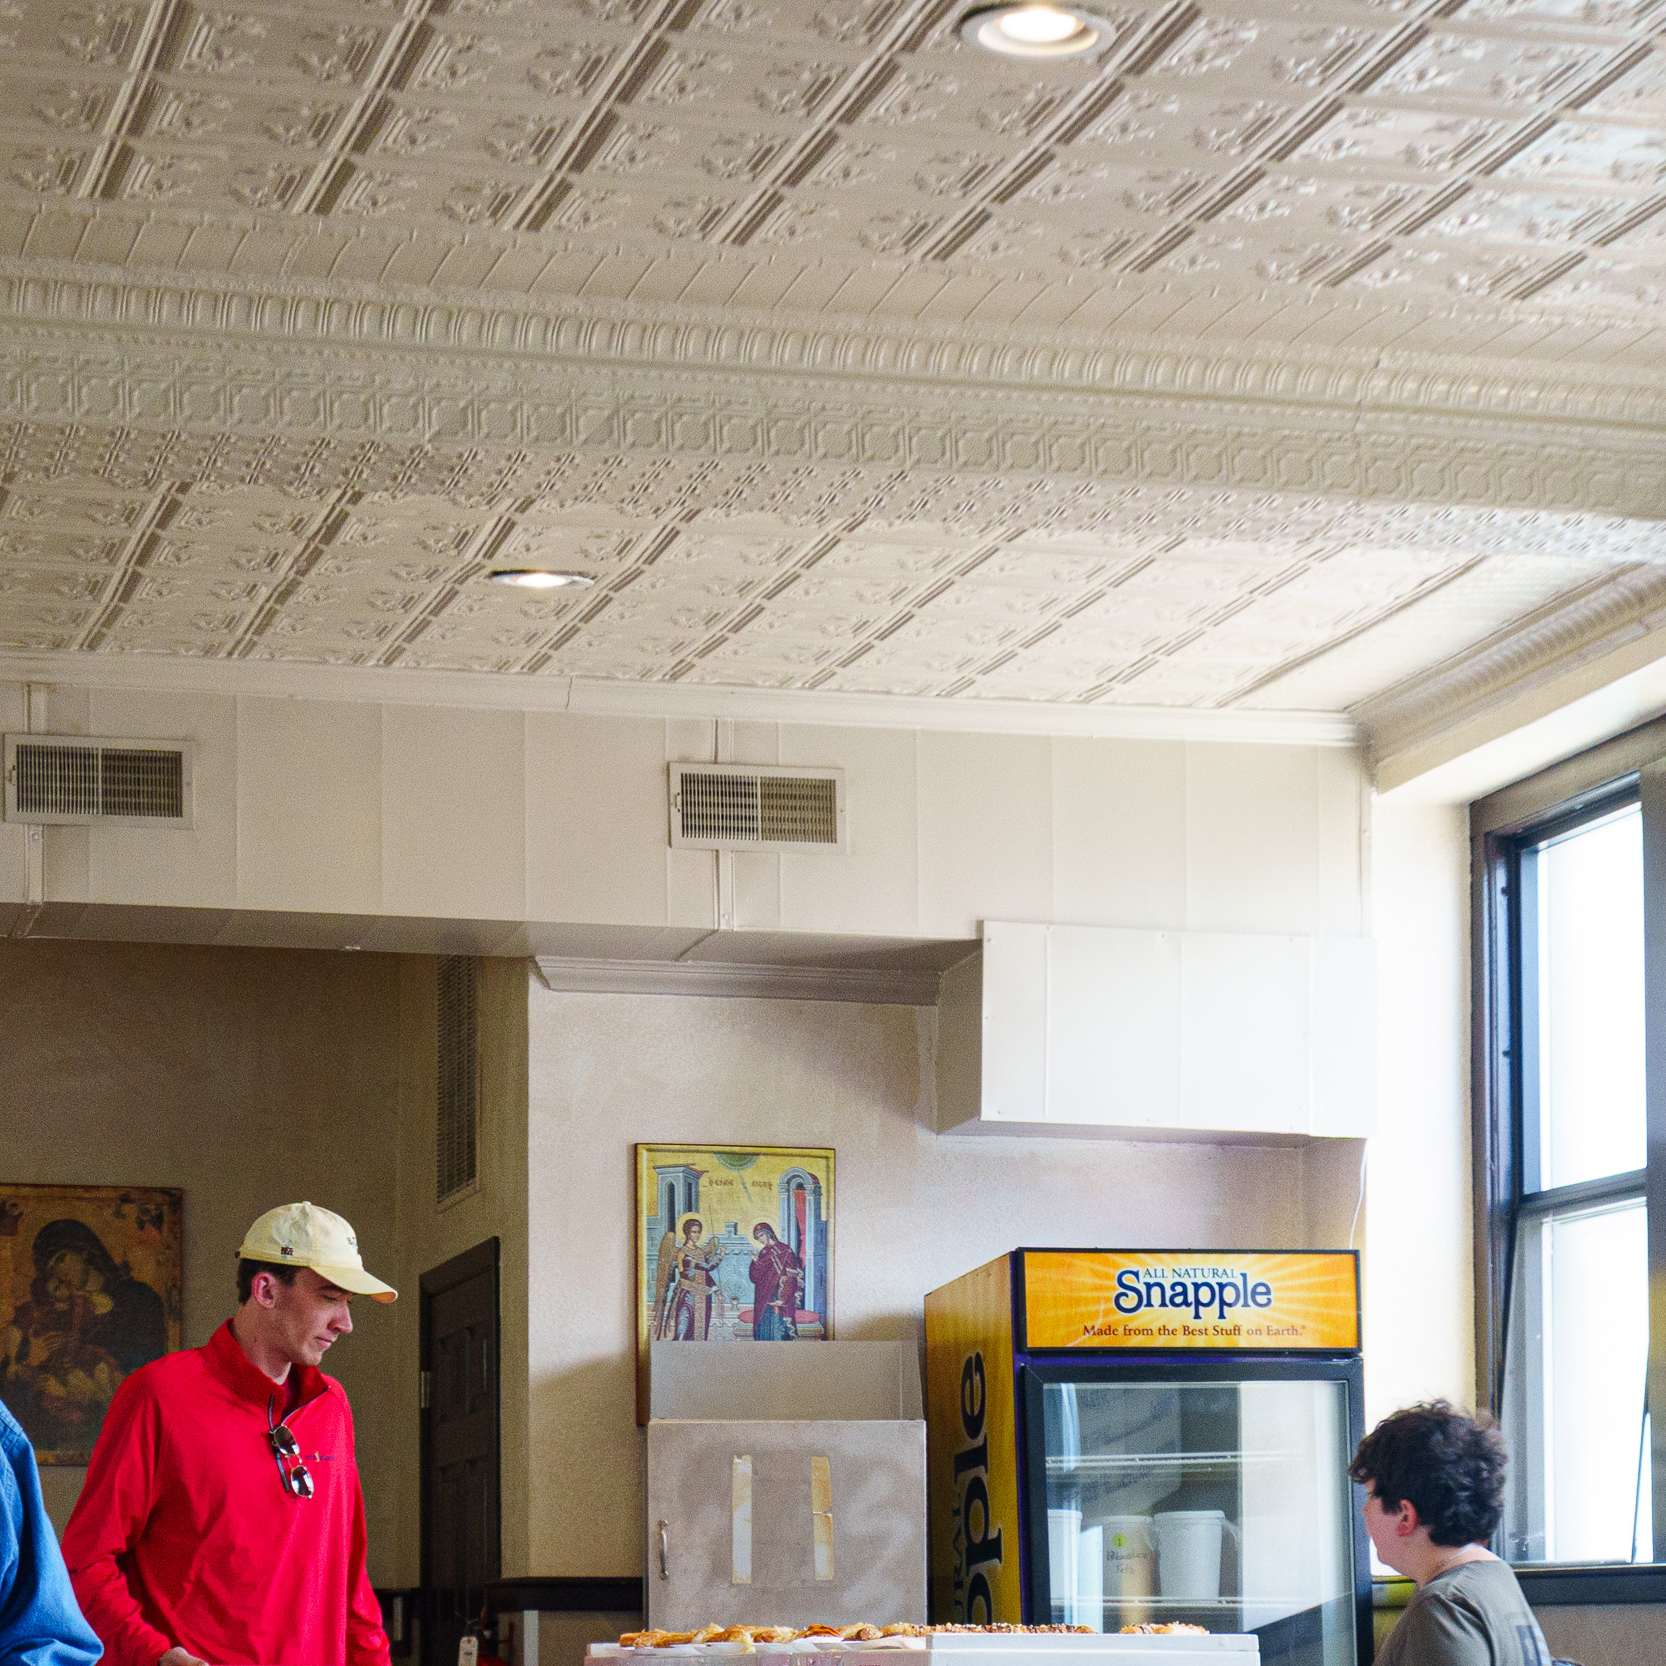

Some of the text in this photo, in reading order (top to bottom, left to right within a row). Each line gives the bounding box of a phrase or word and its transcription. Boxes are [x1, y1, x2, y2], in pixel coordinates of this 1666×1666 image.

[1143, 1268, 1237, 1278] ALL NATURAL
[1114, 1269, 1273, 1320] Snapple
[1083, 1325, 1119, 1337] Made
[1123, 1324, 1153, 1337] from
[1157, 1325, 1178, 1337] the
[1182, 1325, 1209, 1337] Best
[1212, 1324, 1242, 1337] Stuff
[1247, 1327, 1262, 1337] on
